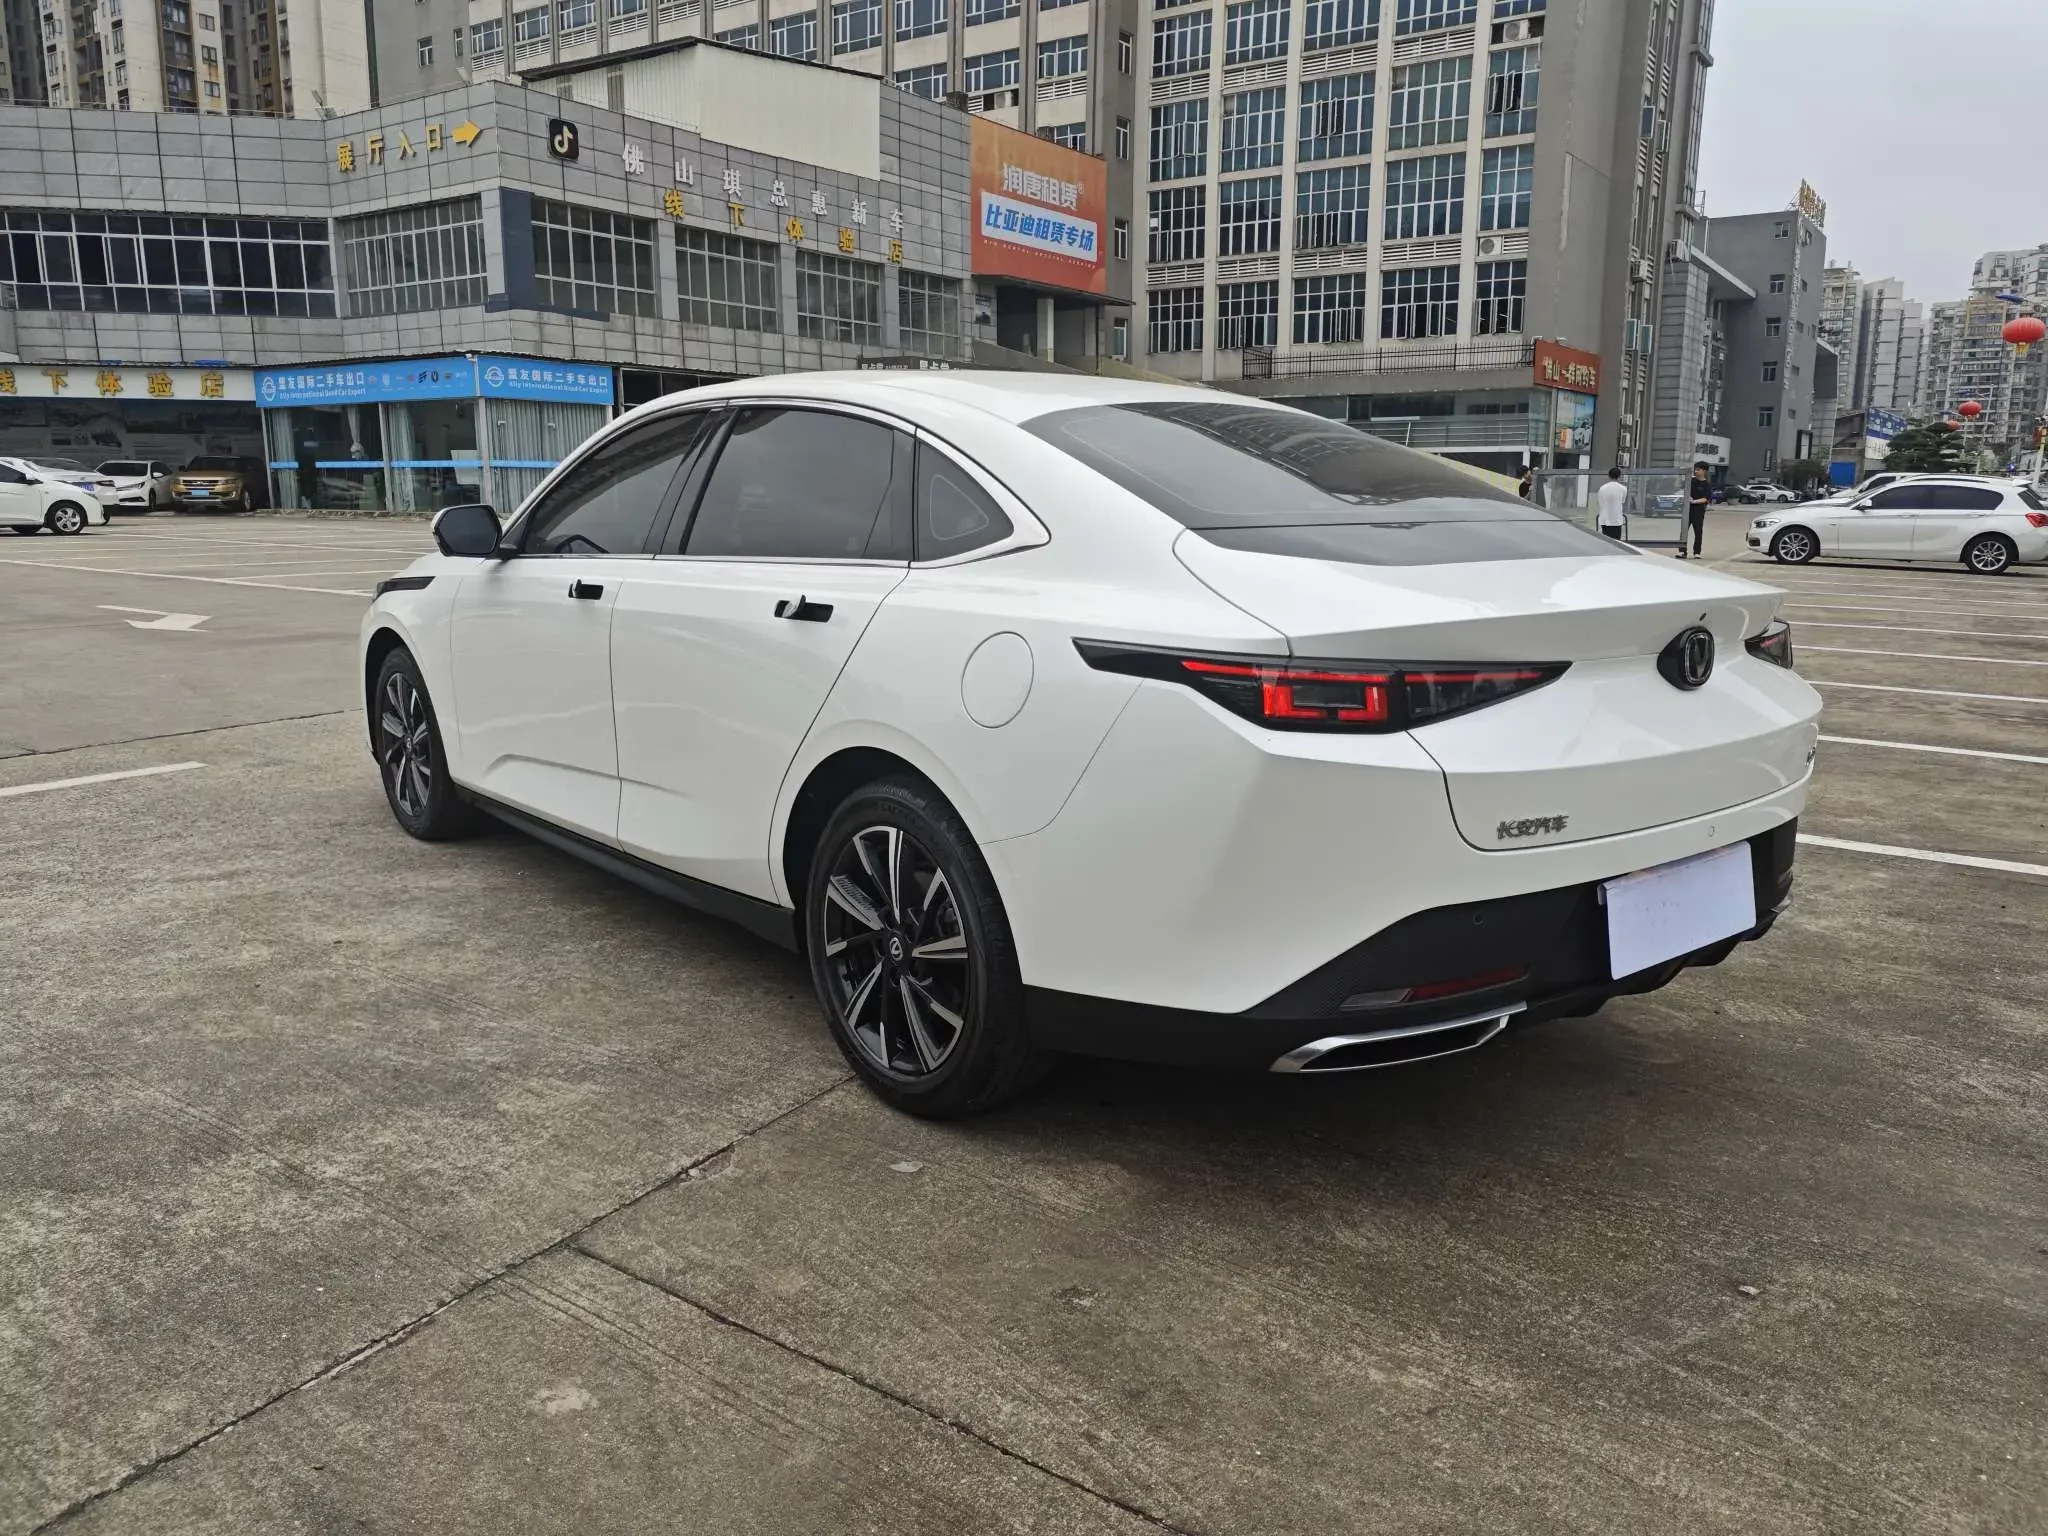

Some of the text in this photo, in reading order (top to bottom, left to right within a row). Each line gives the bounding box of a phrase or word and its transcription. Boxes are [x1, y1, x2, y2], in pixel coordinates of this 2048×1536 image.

[336, 122, 443, 173] 展厅入口
[664, 187, 904, 264] 线下体验店
[985, 203, 1095, 252] 比亚迪租赁专场
[1496, 814, 1570, 840] 长安汽车
